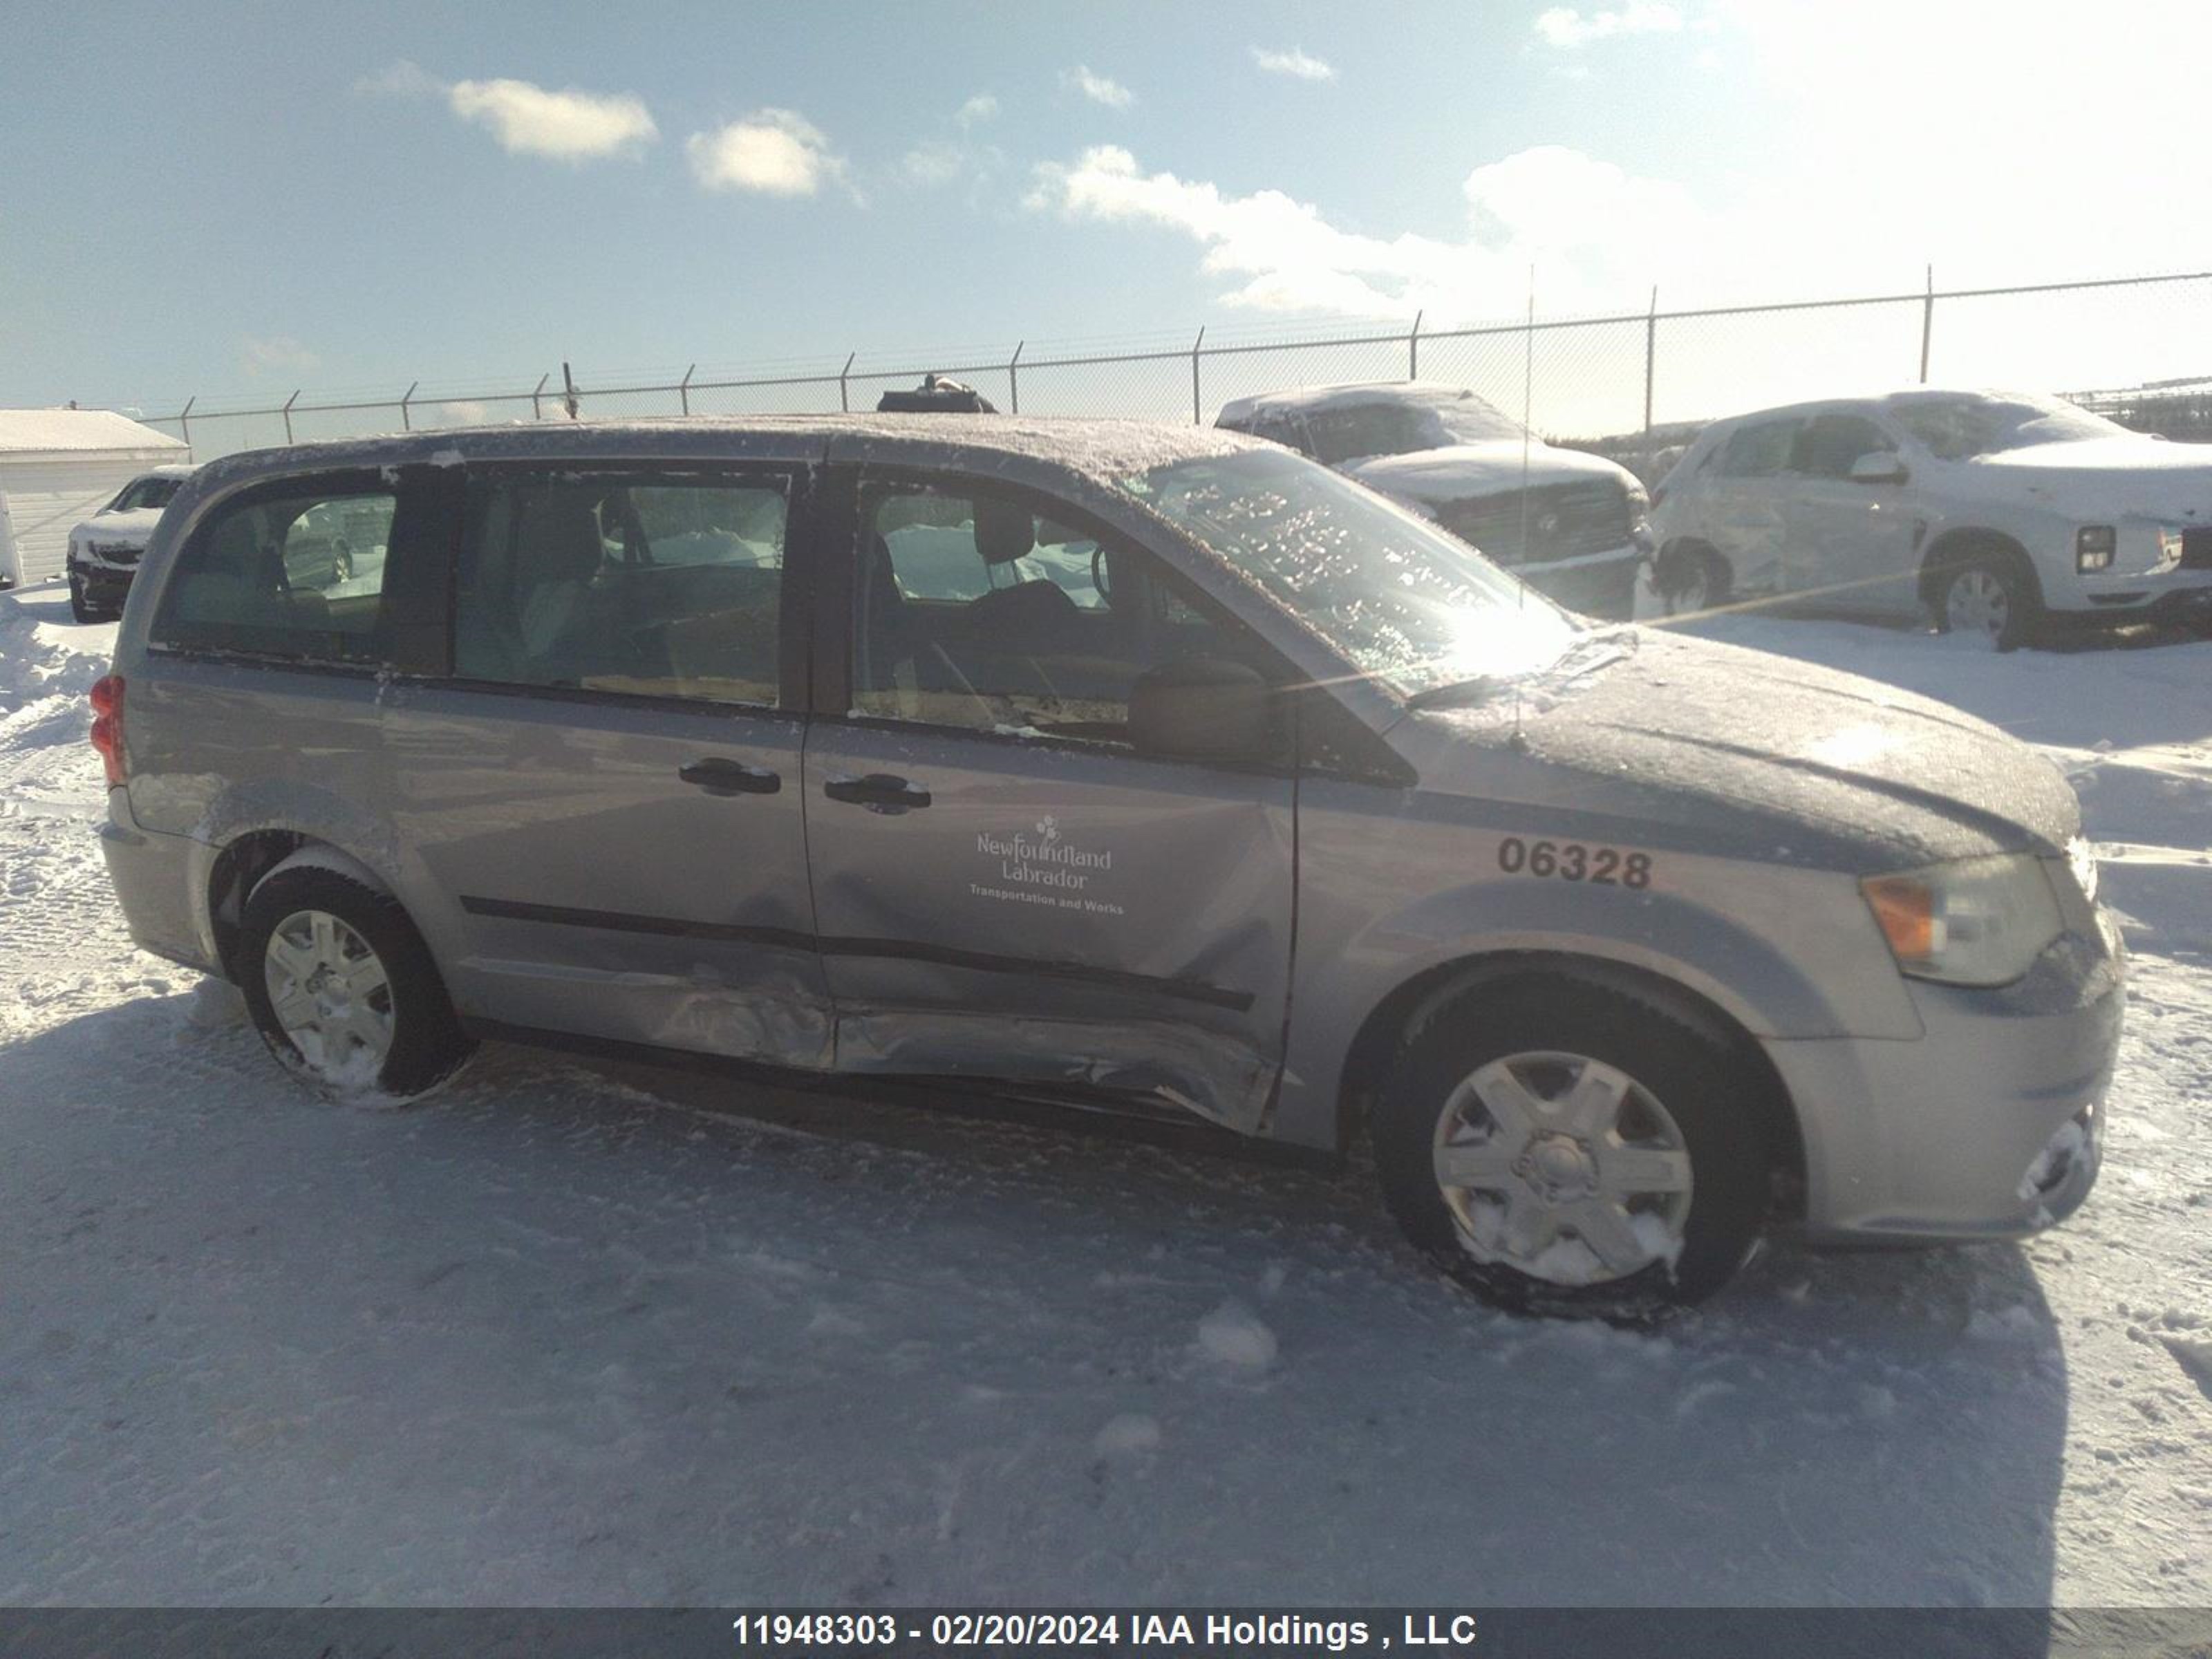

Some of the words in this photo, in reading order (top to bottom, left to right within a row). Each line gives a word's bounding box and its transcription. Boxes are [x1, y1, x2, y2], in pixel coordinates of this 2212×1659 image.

[977, 832, 1112, 870] Newfoundland
[1498, 837, 1652, 890] 06328
[1002, 860, 1088, 890] Labrador
[970, 883, 1056, 906] Transportation
[1058, 899, 1081, 909] and
[1084, 900, 1124, 915] Works
